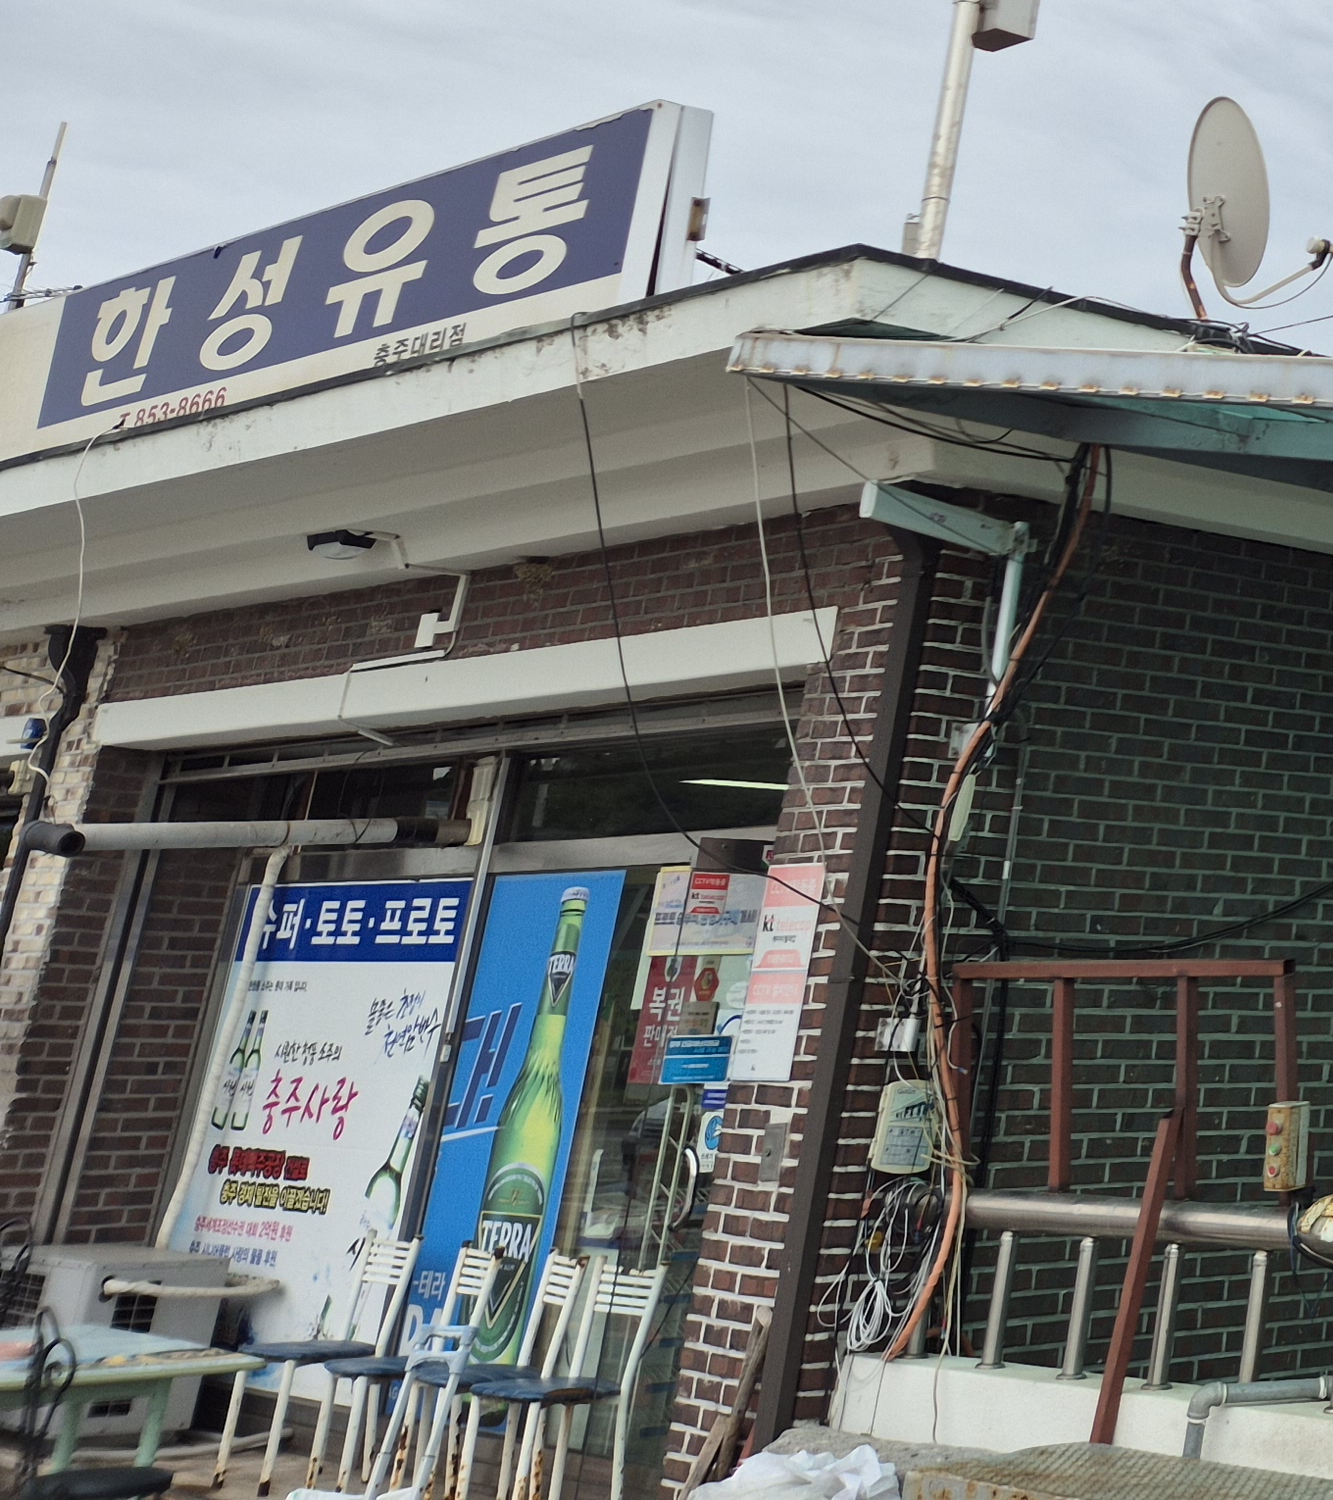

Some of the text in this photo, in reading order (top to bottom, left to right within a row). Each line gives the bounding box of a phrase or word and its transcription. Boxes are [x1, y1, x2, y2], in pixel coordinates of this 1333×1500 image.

[80, 145, 595, 406] 한성유통
[374, 322, 467, 367] 충주대리점
[134, 386, 227, 426] 853-8666
[762, 914, 774, 932] kt
[648, 986, 686, 1022] 복권
[262, 1068, 360, 1140] 충주사랑
[481, 1220, 532, 1264] TERRA
